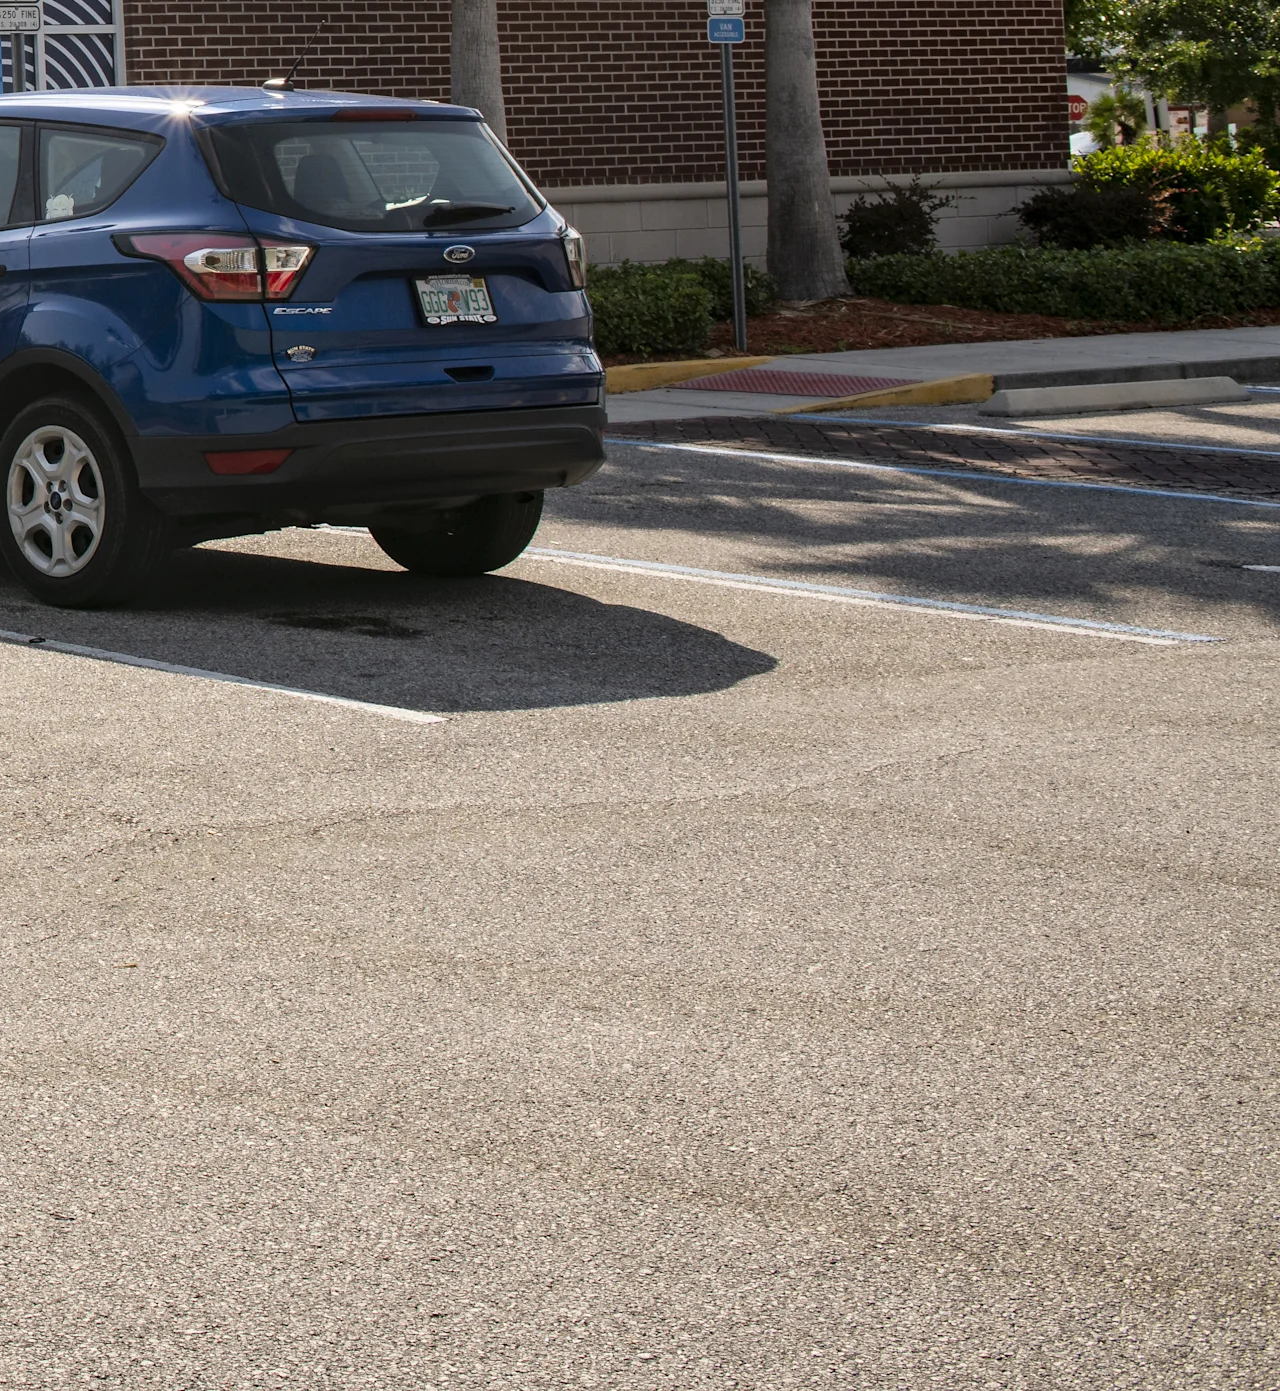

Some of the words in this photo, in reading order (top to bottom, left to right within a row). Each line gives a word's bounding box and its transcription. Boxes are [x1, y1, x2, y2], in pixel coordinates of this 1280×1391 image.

[21, 10, 37, 19] FINE
[719, 23, 733, 31] VAN
[1068, 102, 1087, 113] TOP
[451, 248, 469, 259] Ford
[421, 290, 449, 313] GGG
[460, 288, 490, 312] V93
[272, 307, 333, 315] ESCAPE
[440, 315, 458, 325] SUN
[459, 314, 486, 324] STATE
